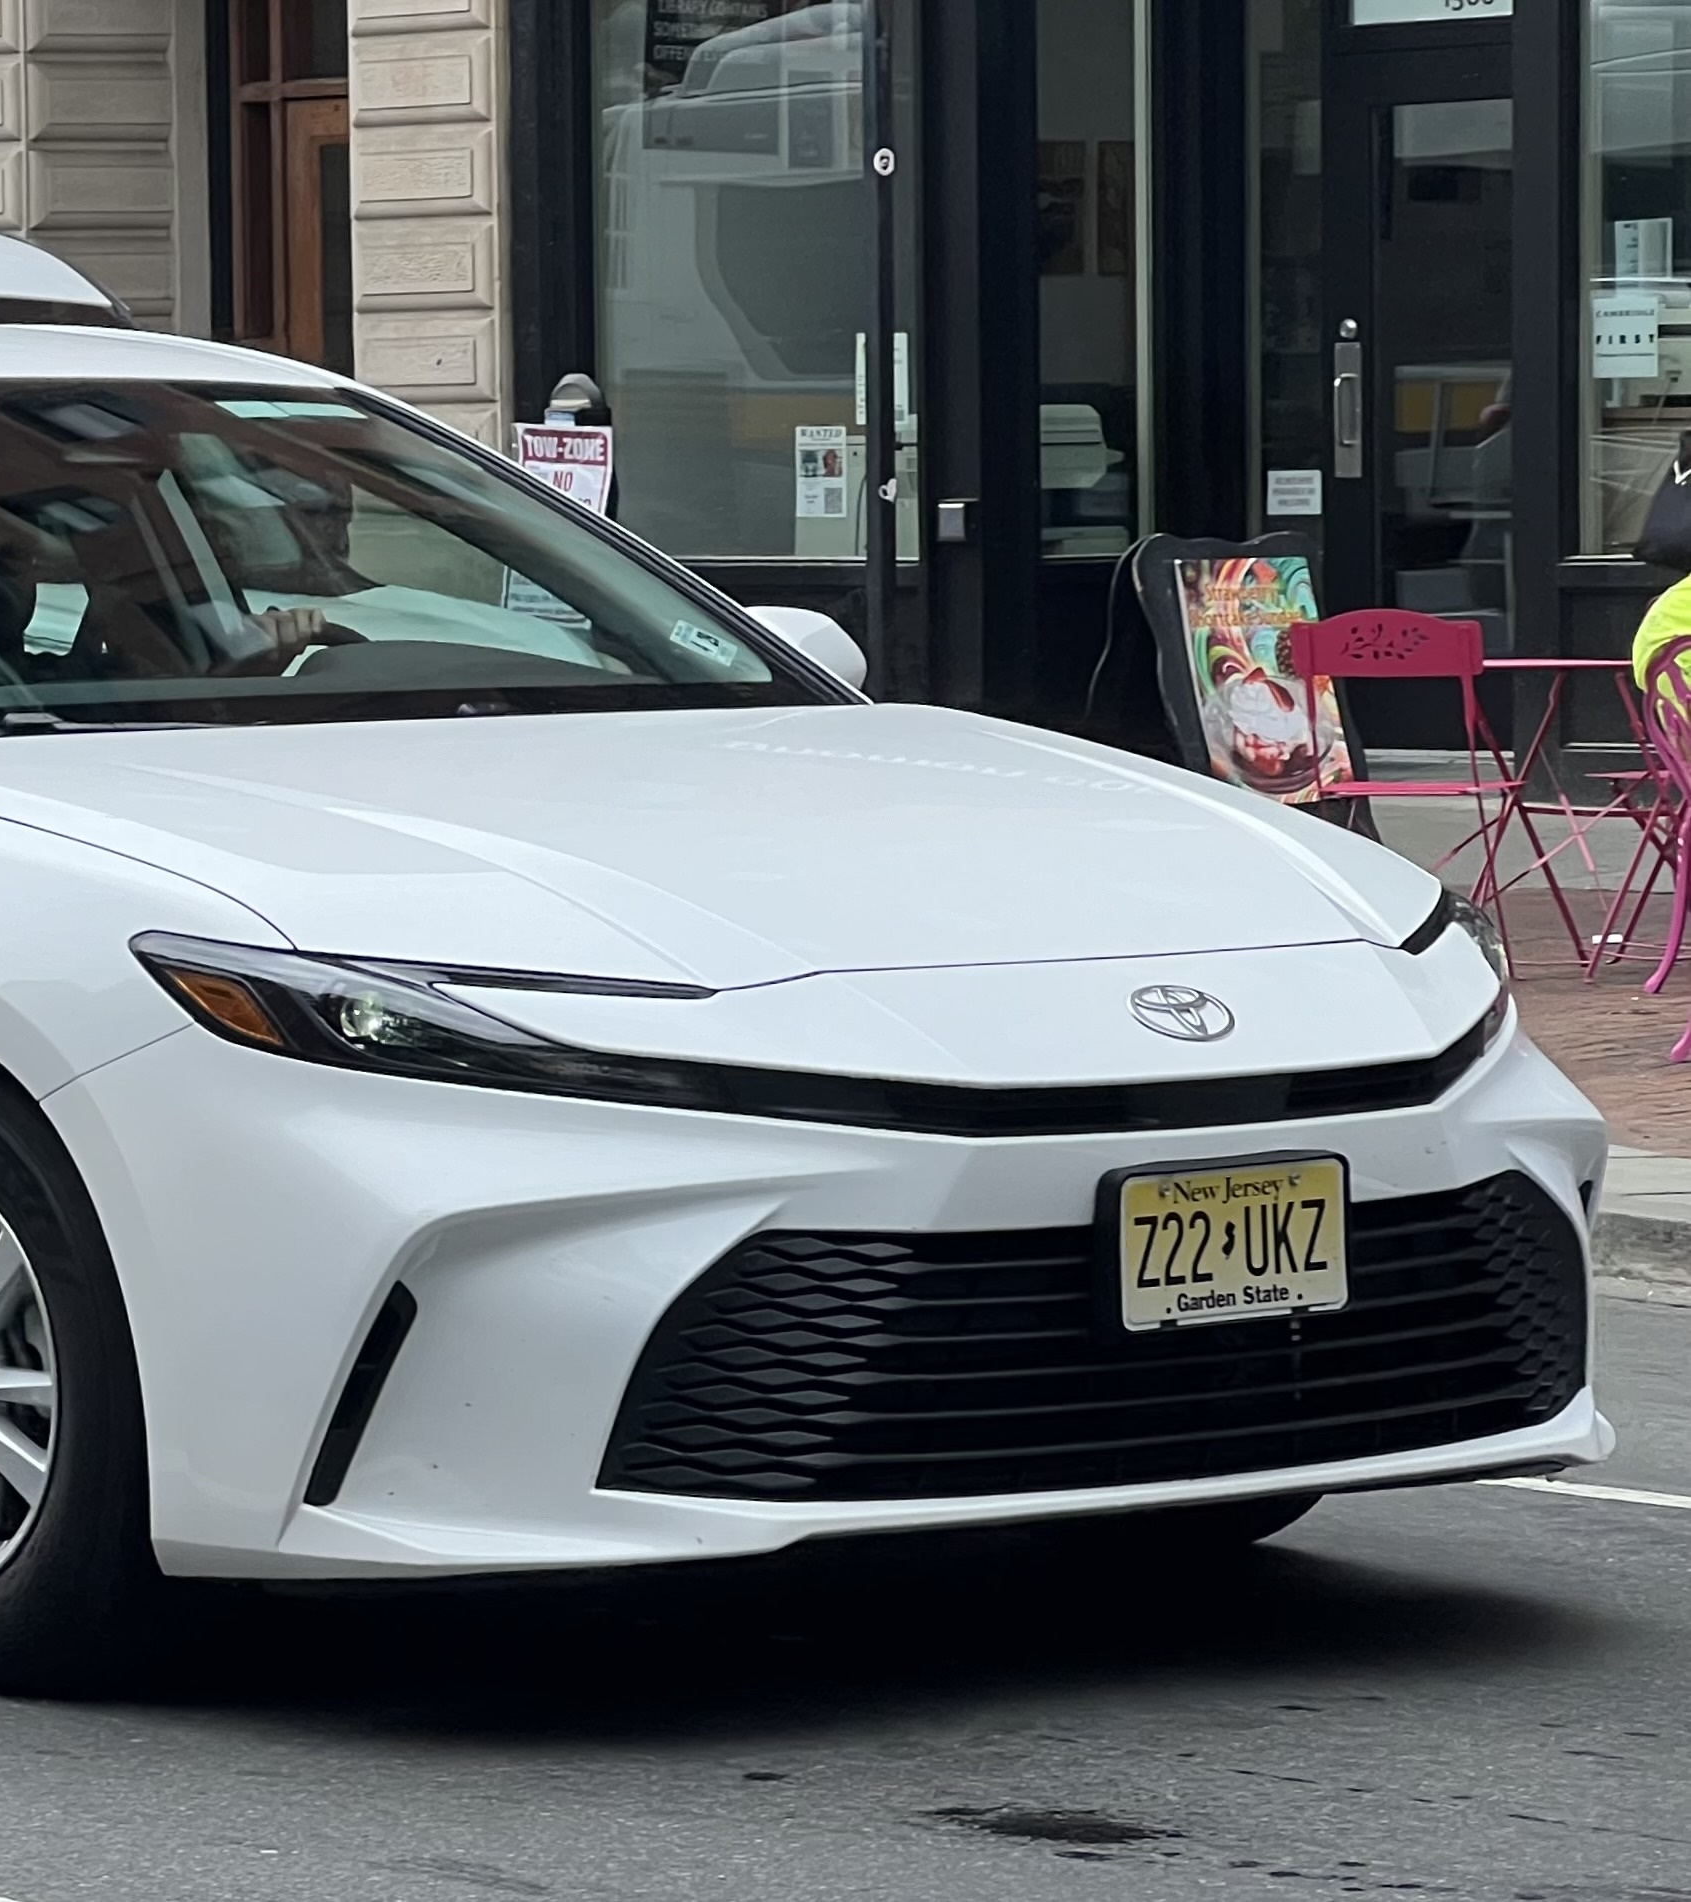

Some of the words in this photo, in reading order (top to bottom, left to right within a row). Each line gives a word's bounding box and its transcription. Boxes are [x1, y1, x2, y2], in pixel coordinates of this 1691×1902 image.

[1595, 333, 1655, 345] FIRST
[524, 434, 605, 461] TOW-ZONE
[553, 470, 574, 493] NO
[1173, 1180, 1221, 1205] New
[1222, 1176, 1285, 1204] Jersey
[1134, 1210, 1214, 1289] Z22
[1243, 1198, 1328, 1277] UKZ
[1177, 1290, 1236, 1313] Garden
[1242, 1285, 1290, 1305] State
